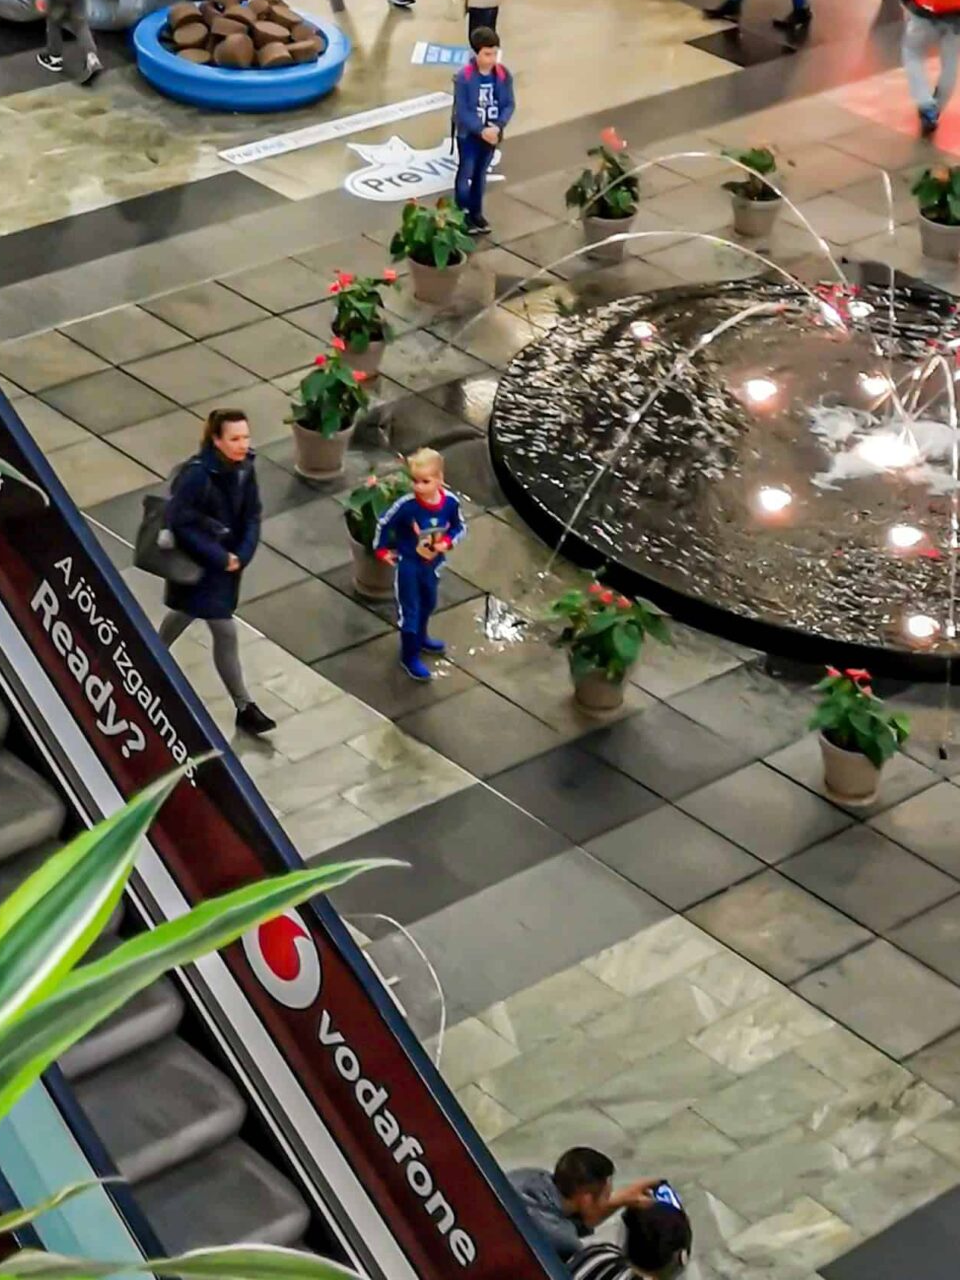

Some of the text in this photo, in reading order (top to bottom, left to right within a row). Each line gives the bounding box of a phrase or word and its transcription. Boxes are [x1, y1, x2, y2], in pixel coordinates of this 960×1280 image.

[30, 579, 147, 759] Ready?
[54, 556, 198, 789] A jövő izgalmas.
[318, 1009, 477, 1267] vodafone
